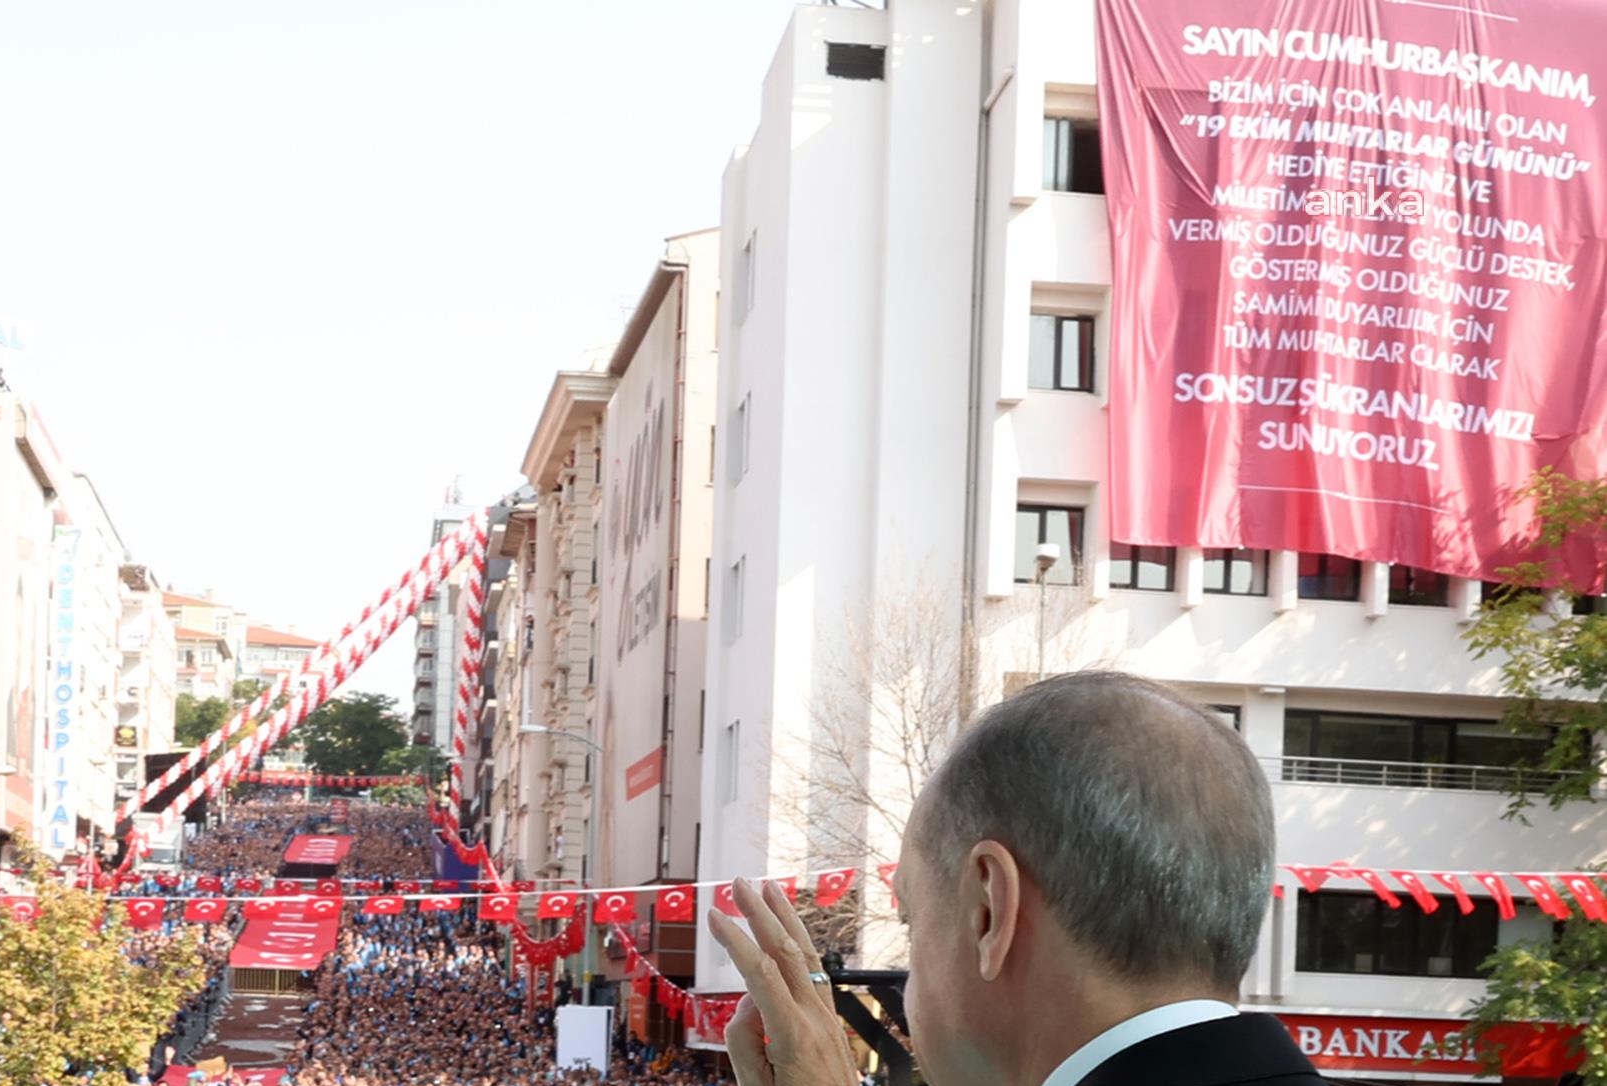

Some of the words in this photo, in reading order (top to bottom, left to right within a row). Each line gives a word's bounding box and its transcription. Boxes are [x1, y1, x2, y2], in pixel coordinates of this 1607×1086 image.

[1182, 25, 1276, 58] SAYIN
[1284, 30, 1596, 108] CUMHURBAŞKANIM,
[1208, 76, 1274, 104] BİZİM
[1278, 79, 1328, 111] İÇİN
[1333, 87, 1384, 116] ÇOK
[1388, 97, 1491, 134] ANLAMLI
[1495, 114, 1567, 145] OLAN
[1230, 112, 1292, 142] EKİM
[1296, 120, 1450, 160] MUHTARLAR
[1266, 153, 1347, 181] HEDİYE
[1349, 159, 1457, 193] ETTİĞİNİZ
[1464, 178, 1492, 204] VE
[1433, 203, 1546, 246] YOLUNDA
[1168, 219, 1252, 244] VERMİŞ
[1254, 220, 1405, 259] OLDUĞUNUZ
[1408, 237, 1486, 273] GÜÇLÜ
[1490, 252, 1576, 291] DESTEK,
[1229, 254, 1352, 293] GÖSTERMİŞ
[1356, 268, 1511, 312] OLDUĞUNUZ
[1232, 289, 1323, 317] SAMİMİ
[1322, 295, 1441, 333] DUYARLILIK
[1441, 315, 1495, 347] İÇİN
[1223, 324, 1271, 350] TÜM
[1277, 330, 1406, 364] MUHTARLAR
[1409, 342, 1501, 381] OLARAK
[1174, 372, 1296, 405] SONSUZ
[1298, 373, 1536, 442] ŞÜKRANLARIMIZI
[50, 660, 73, 850] HOSPITAL
[1298, 1025, 1476, 1062] BANKASI
